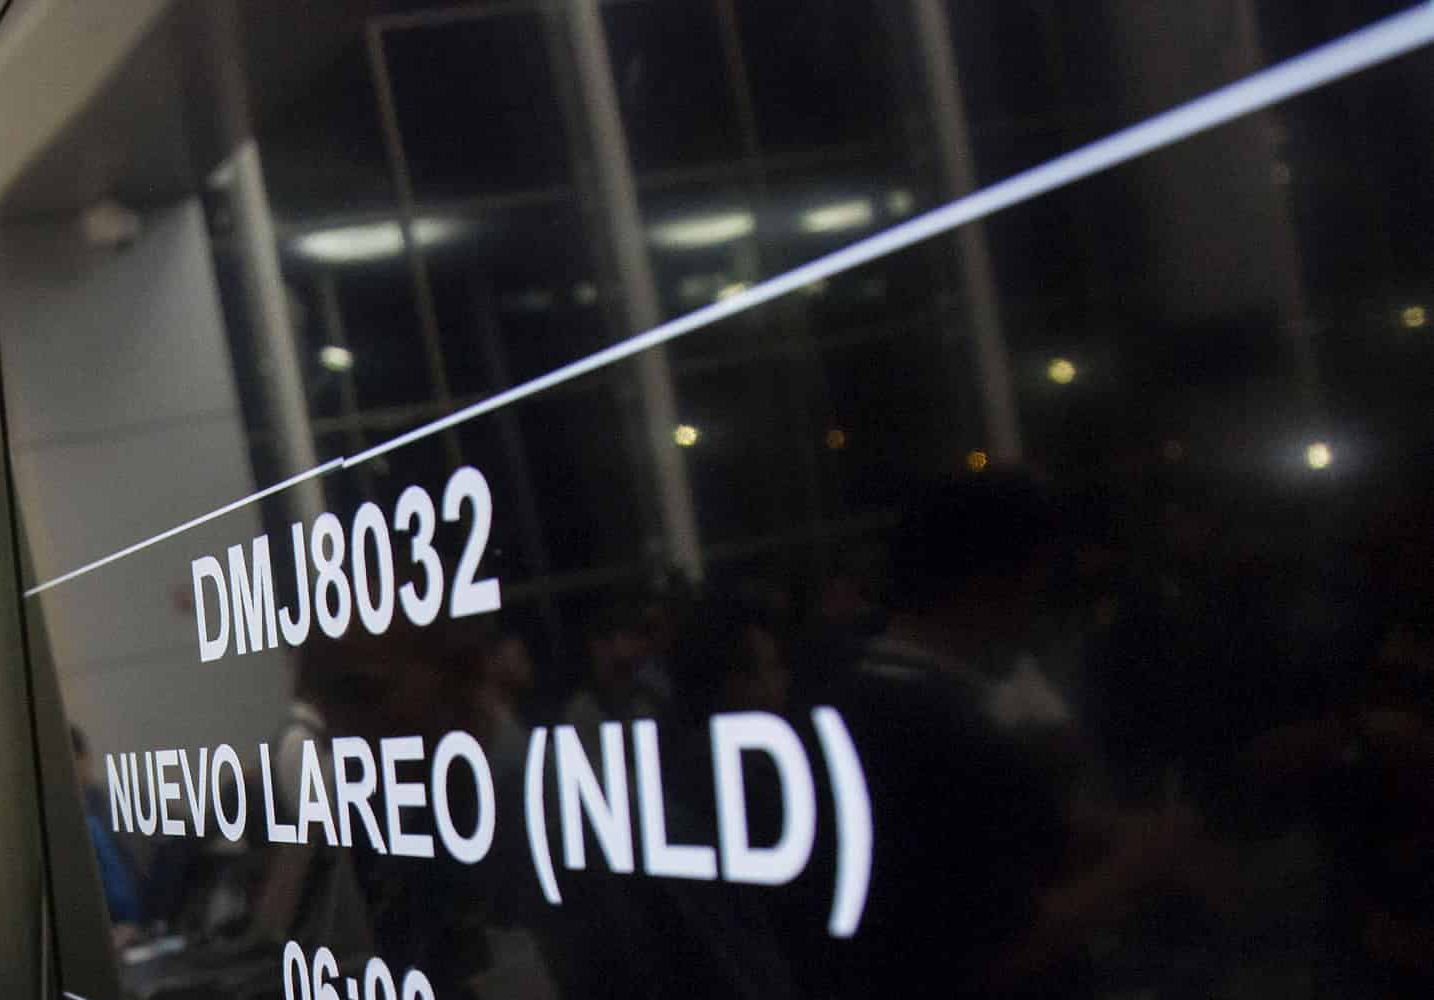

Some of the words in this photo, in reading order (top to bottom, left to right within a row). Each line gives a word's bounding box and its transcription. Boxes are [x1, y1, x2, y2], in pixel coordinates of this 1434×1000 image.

[191, 466, 501, 663] DMJ8032
[105, 743, 247, 842] NUEVO
[259, 731, 496, 864] LAREO
[524, 706, 874, 937] (NLD)
